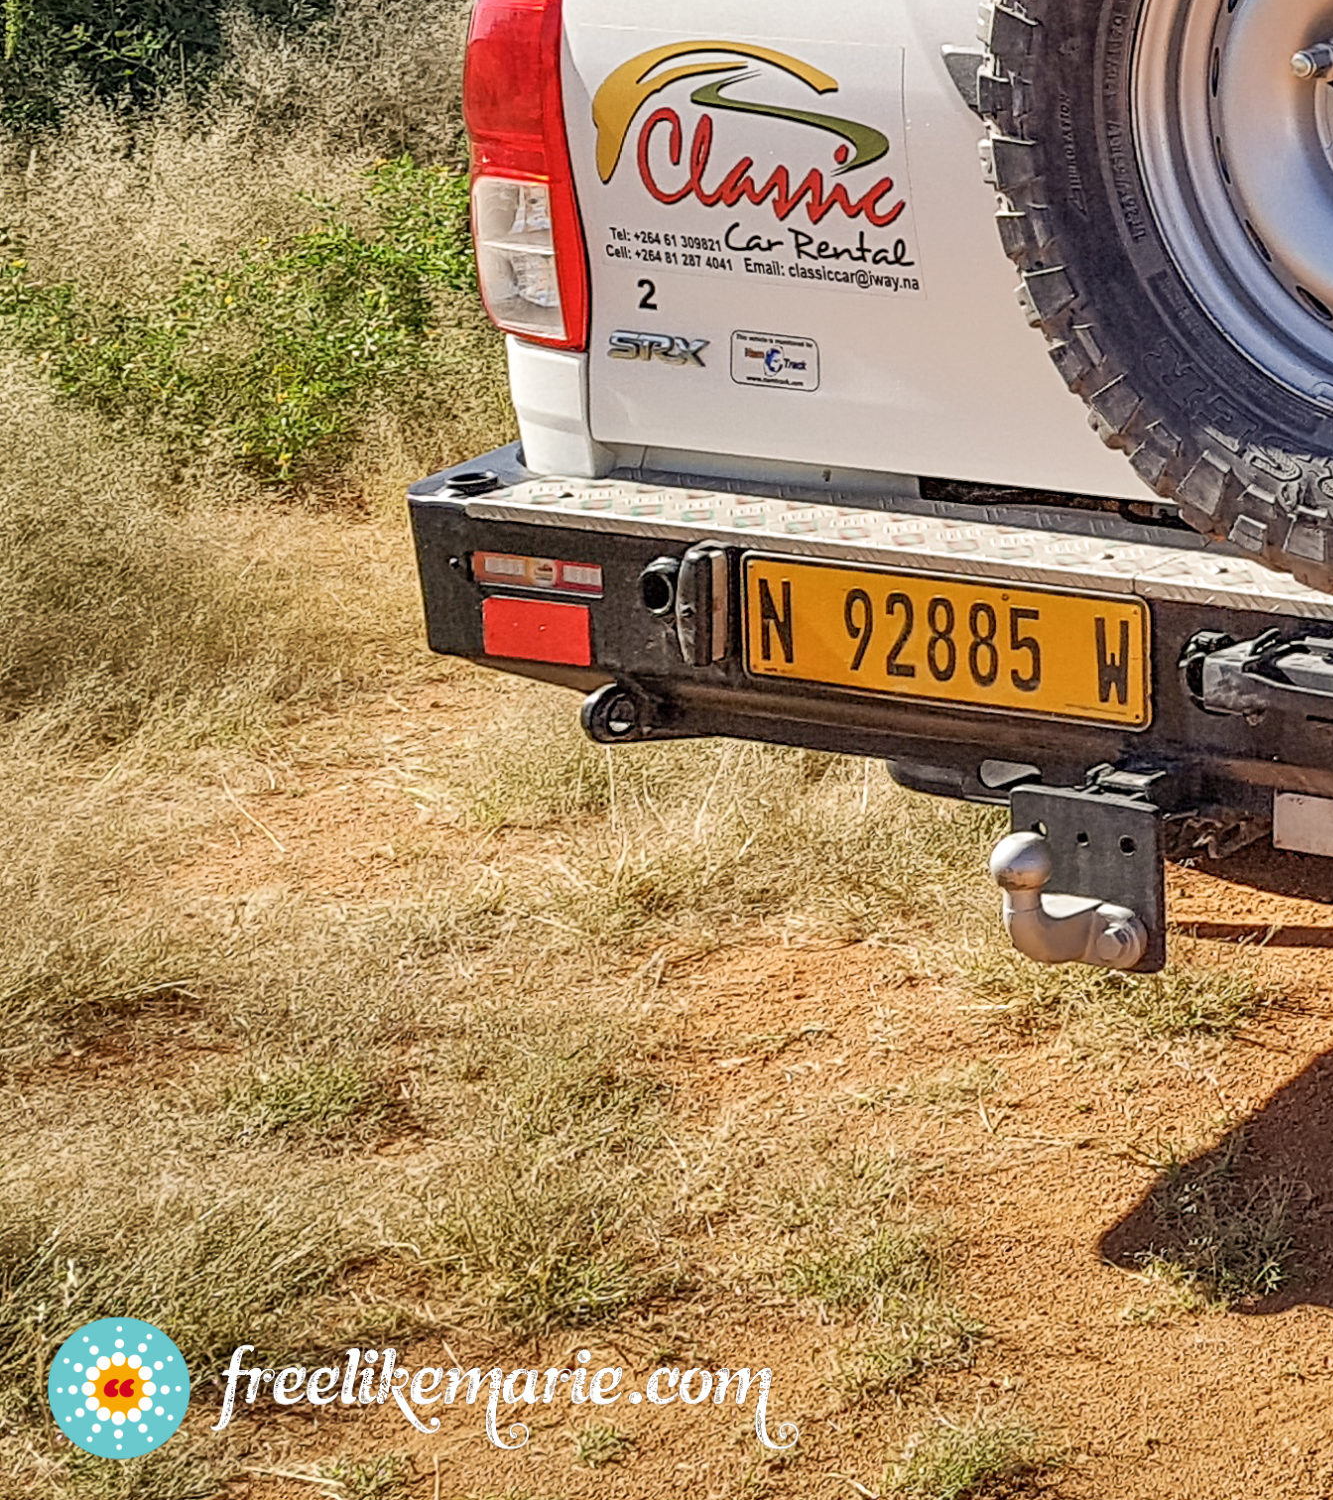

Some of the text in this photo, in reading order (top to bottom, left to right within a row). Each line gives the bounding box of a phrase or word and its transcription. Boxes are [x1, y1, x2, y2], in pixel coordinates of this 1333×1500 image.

[637, 107, 906, 227] Classic
[609, 226, 721, 252] Tel: +264 61 309821
[725, 222, 915, 267] Car Rental
[605, 243, 920, 291] Cell: +264 81 287 4041 Email: classiccar@iway.na
[637, 278, 658, 311] 2
[606, 329, 711, 368] SRX
[758, 578, 1130, 705] N 92885 W
